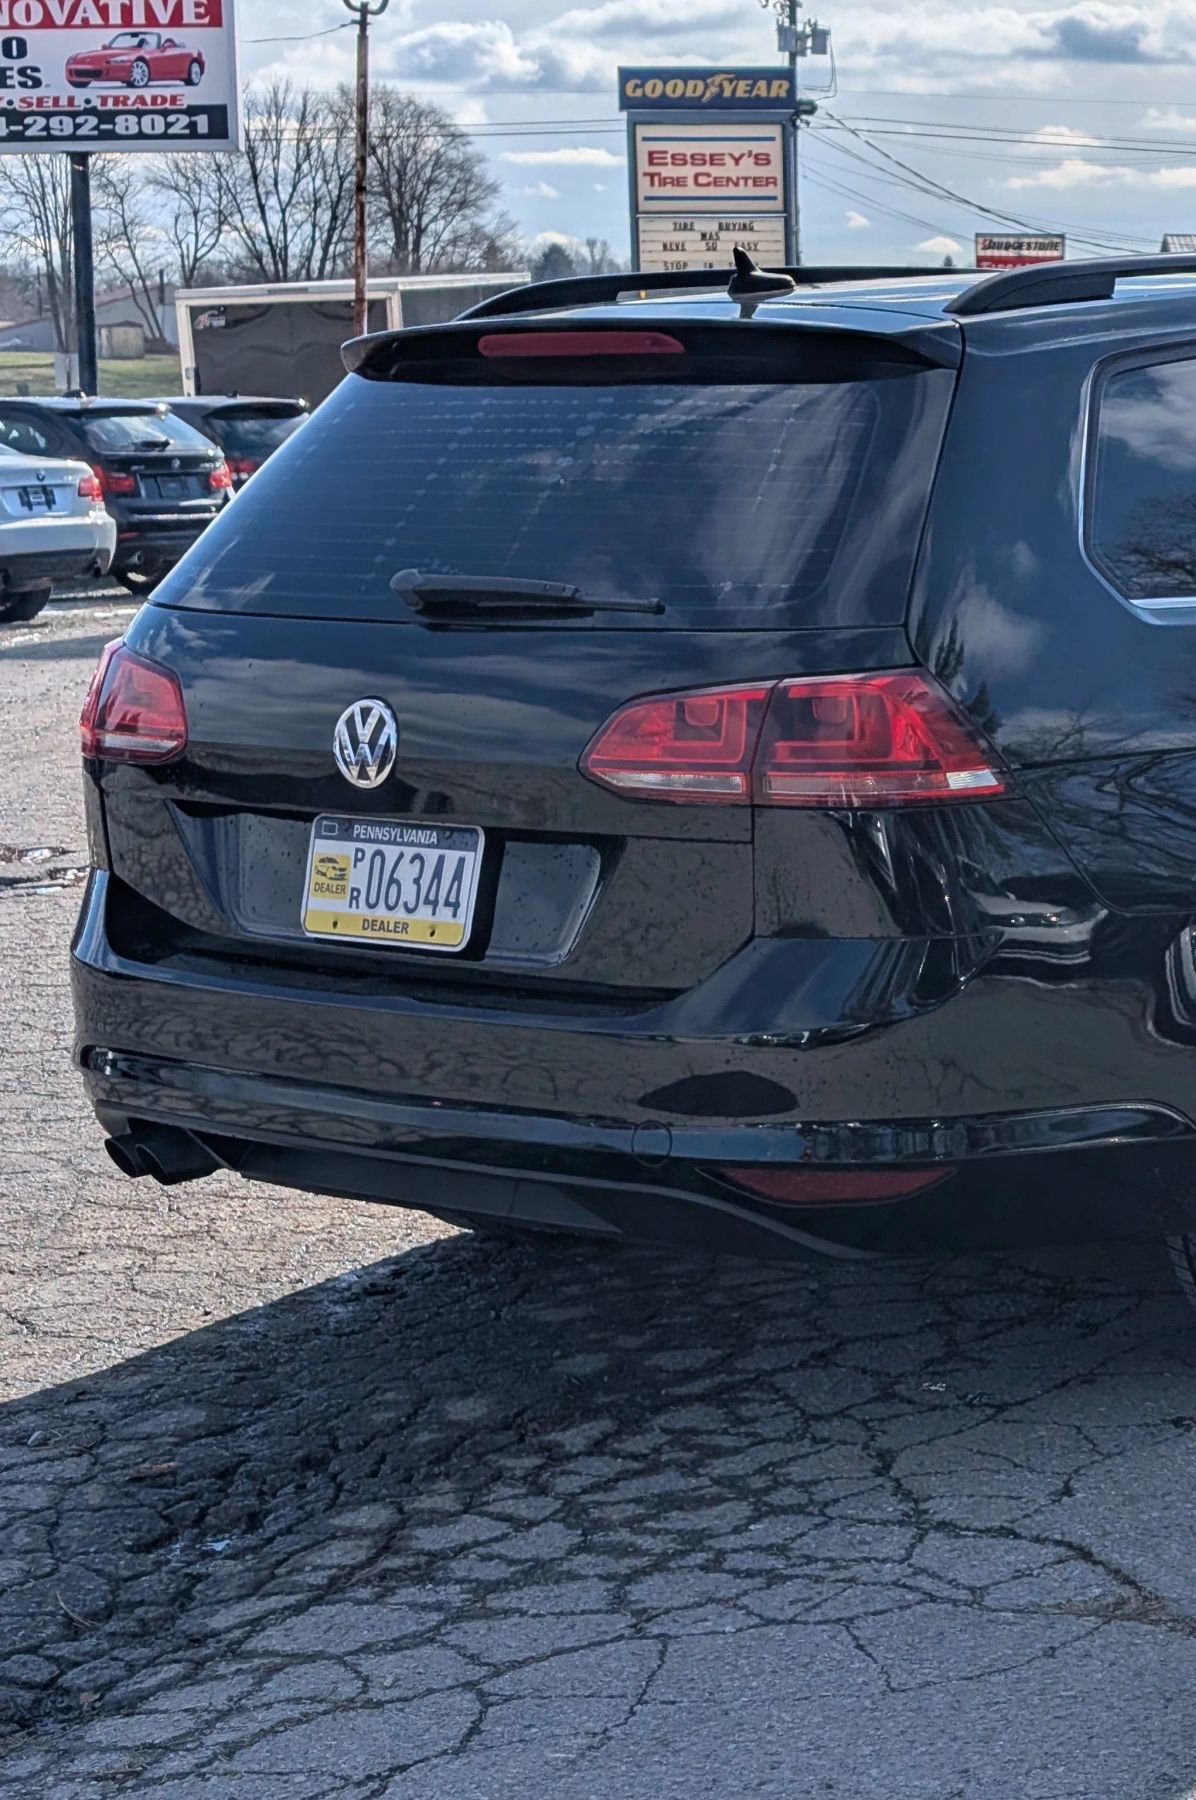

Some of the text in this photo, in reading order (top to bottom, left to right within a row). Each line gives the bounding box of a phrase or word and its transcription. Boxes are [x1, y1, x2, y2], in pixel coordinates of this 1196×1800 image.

[625, 77, 790, 100] GOODYEAR
[18, 96, 82, 108] SELL
[96, 94, 186, 107] TRADE
[647, 150, 772, 167] ESSEY'S
[643, 172, 778, 187] TIRE CENTER
[672, 221, 755, 231] TIRE BUYING
[700, 231, 720, 241] WAS
[662, 241, 687, 251] NEVE
[705, 241, 718, 251] SO
[664, 261, 688, 271] STOP
[353, 824, 438, 845] PENNSYLVANIA
[313, 883, 346, 895] DEALER
[362, 918, 410, 935] DEALER
